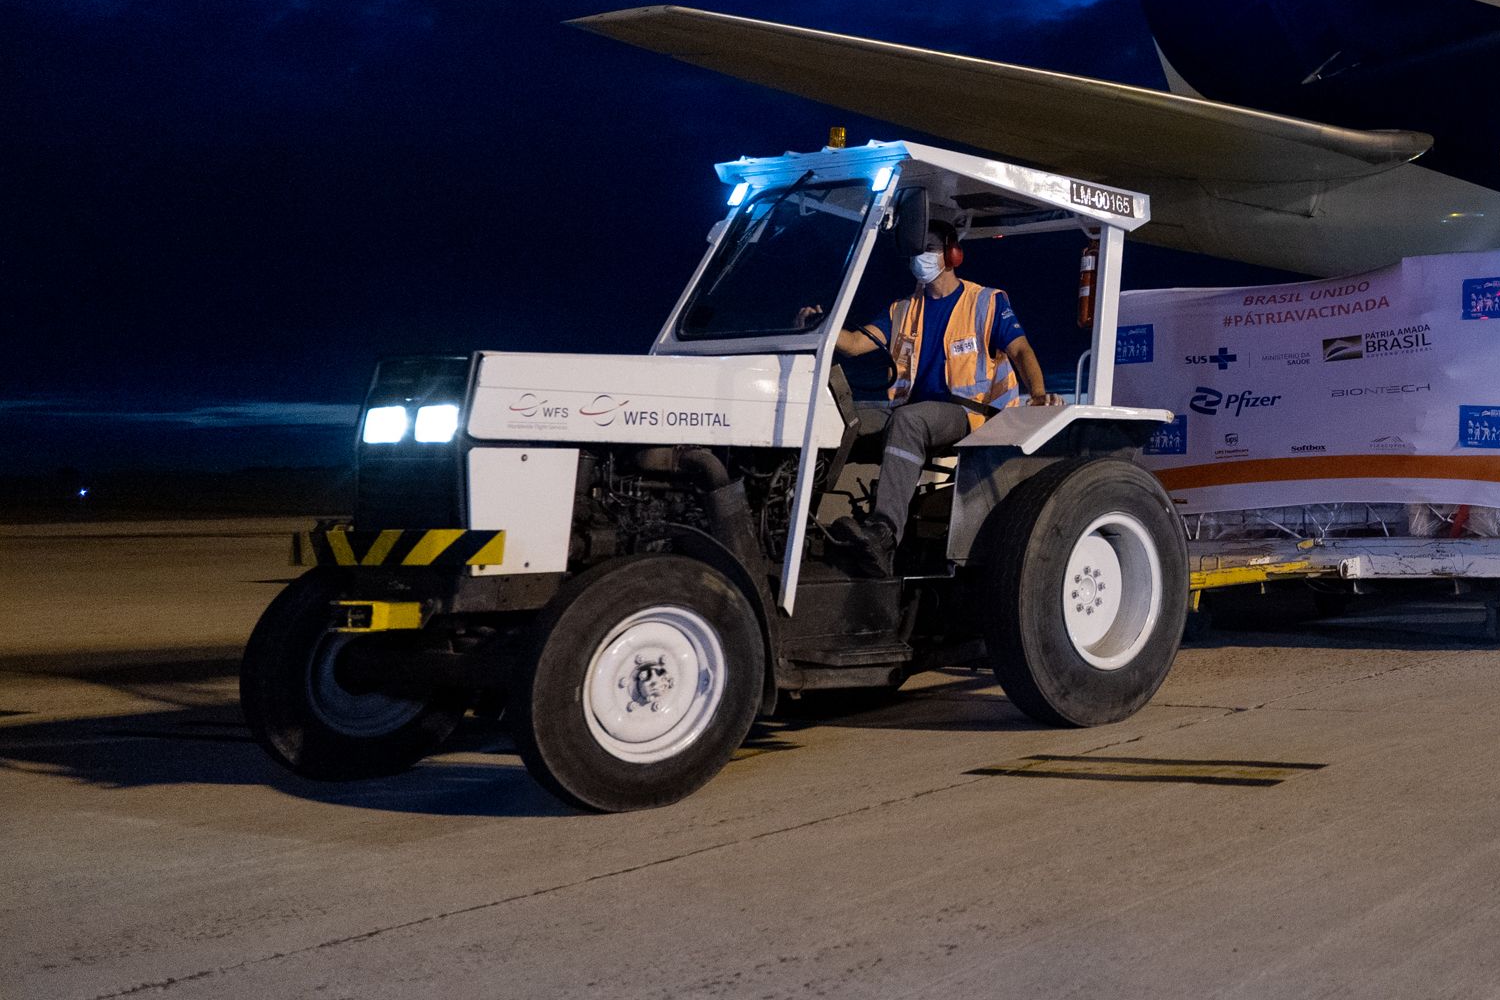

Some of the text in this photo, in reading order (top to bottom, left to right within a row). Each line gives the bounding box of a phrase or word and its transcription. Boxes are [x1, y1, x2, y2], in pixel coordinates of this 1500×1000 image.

[1073, 183, 1131, 214] LM-00165
[1243, 280, 1370, 306] BRASIL UNIDO
[1222, 295, 1390, 328] #PÁTRIAVACINADA
[1365, 324, 1431, 341] PÁTRIA AMADA
[1365, 333, 1432, 353] BRASIL
[1185, 355, 1208, 365] SUS
[543, 407, 569, 418] WFS
[1225, 390, 1282, 417] Pfizer
[623, 410, 731, 427] WFS ORBITAL
[1291, 444, 1326, 452] Softbox
